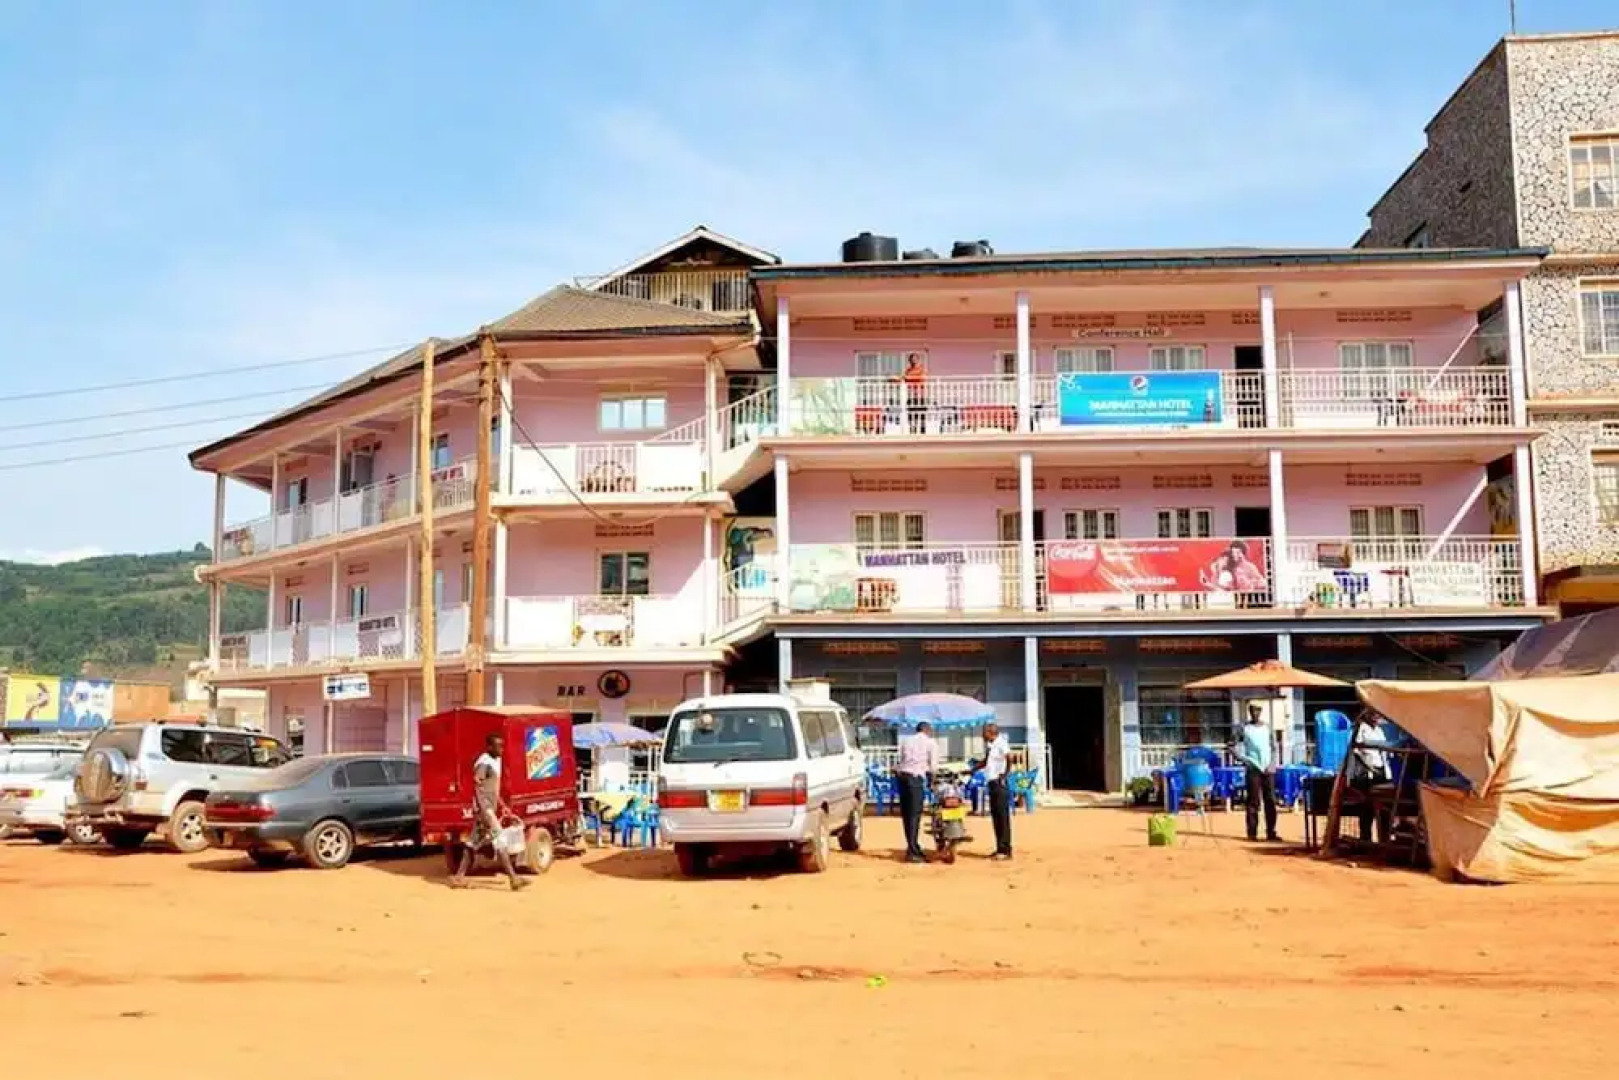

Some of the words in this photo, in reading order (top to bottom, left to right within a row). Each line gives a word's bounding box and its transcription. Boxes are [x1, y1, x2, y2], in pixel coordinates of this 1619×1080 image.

[1078, 327, 1141, 338] Conference
[1143, 326, 1165, 337] Hall
[1088, 399, 1157, 410] MANHATTAN
[1158, 399, 1193, 409] HOTEL
[865, 552, 930, 567] MANHATTAN
[932, 551, 965, 565] HOTEL
[557, 685, 585, 697] BAR
